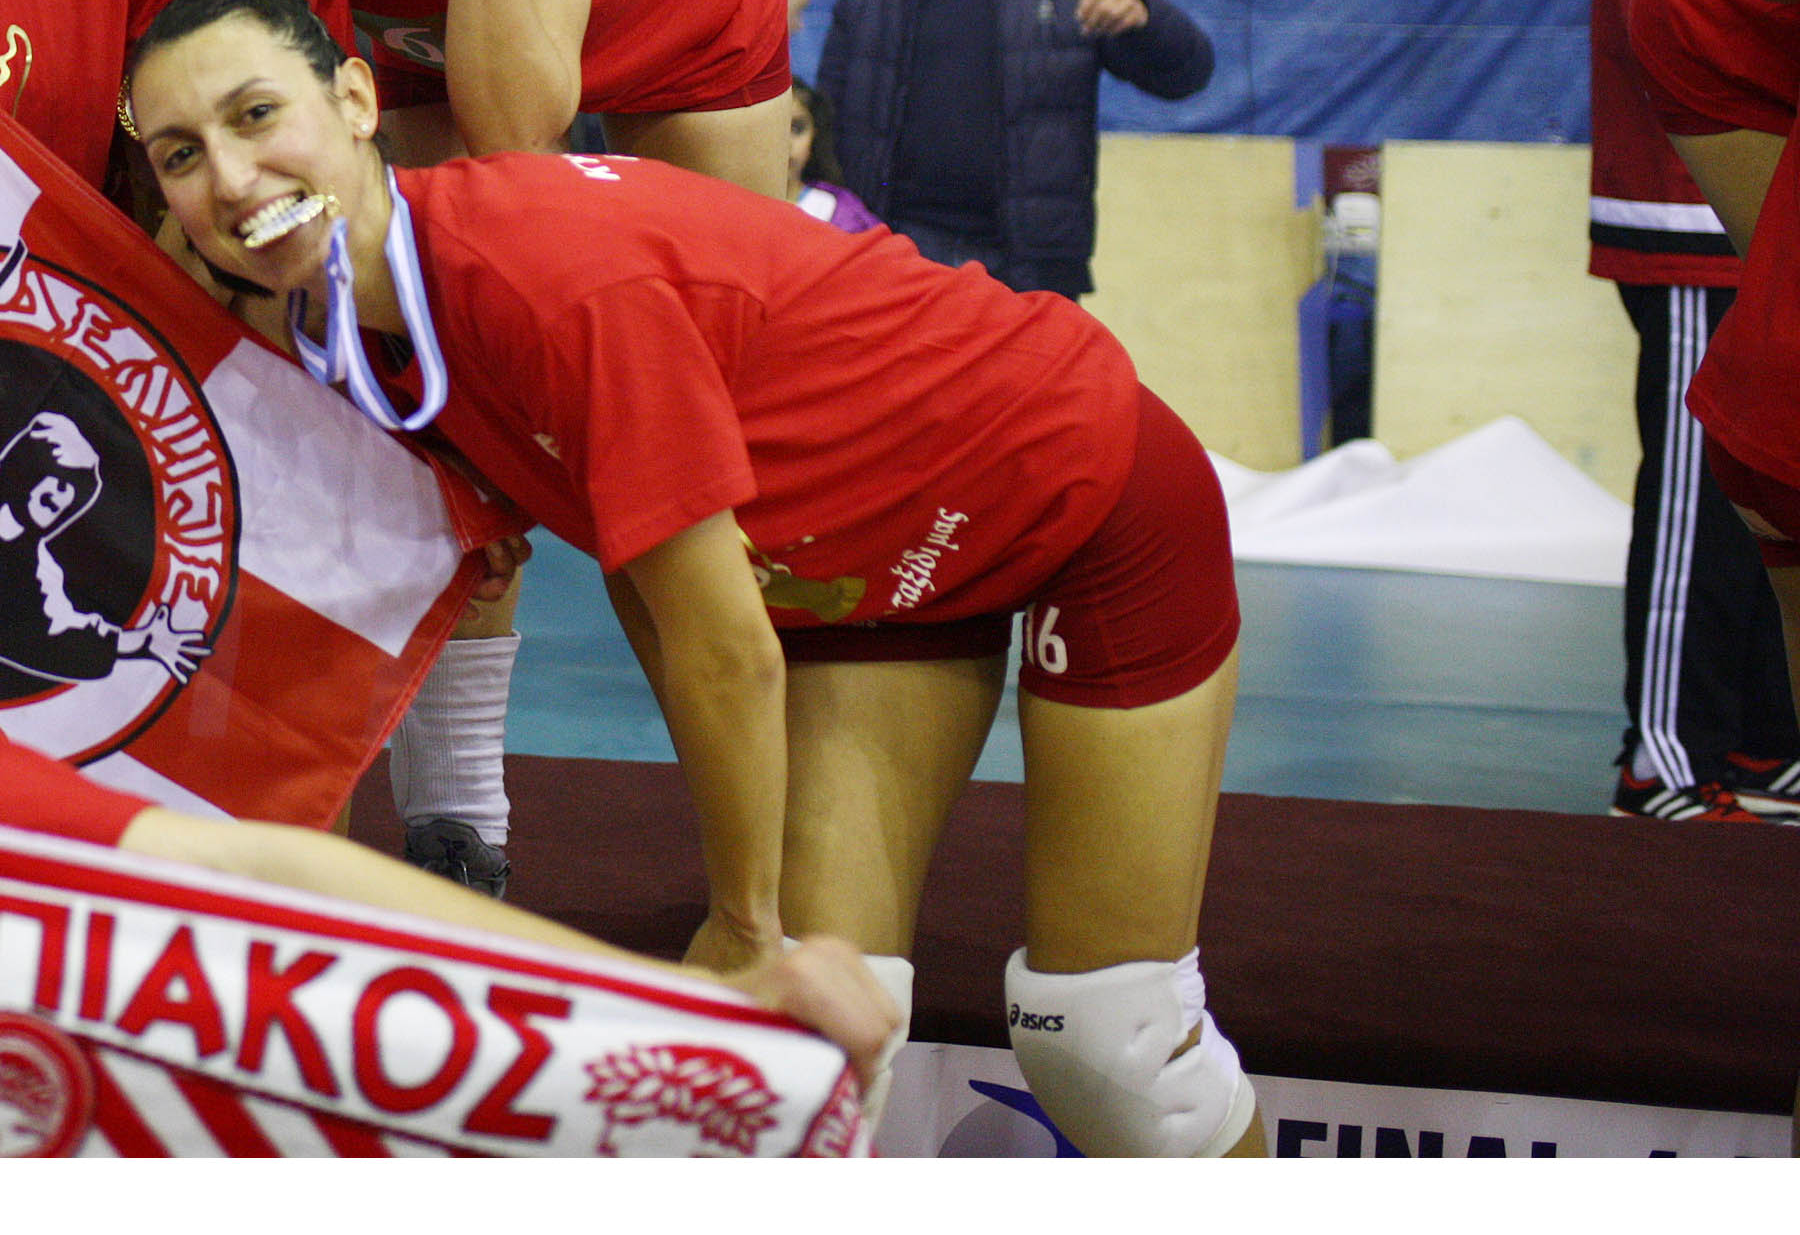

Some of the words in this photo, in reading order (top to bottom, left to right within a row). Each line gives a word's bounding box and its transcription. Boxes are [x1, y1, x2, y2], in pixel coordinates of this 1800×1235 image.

[926, 507, 970, 551] μας
[1026, 606, 1068, 674] 16
[1021, 1012, 1065, 1032] asics
